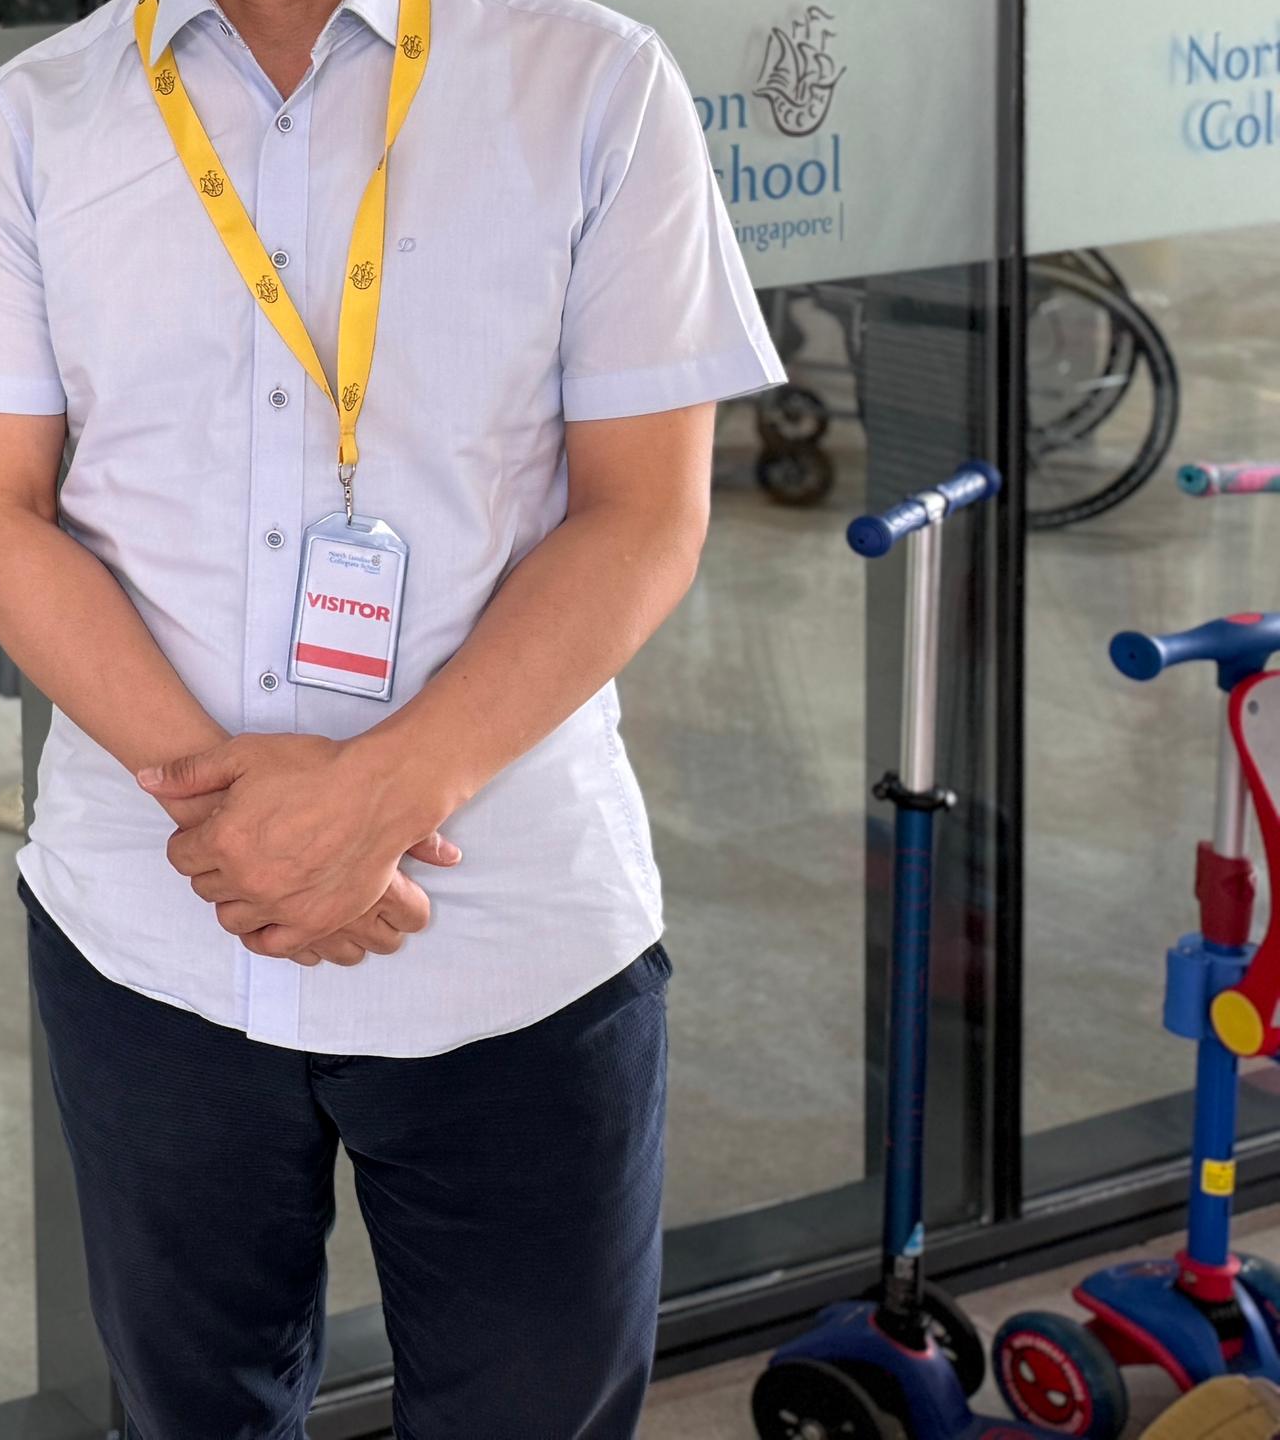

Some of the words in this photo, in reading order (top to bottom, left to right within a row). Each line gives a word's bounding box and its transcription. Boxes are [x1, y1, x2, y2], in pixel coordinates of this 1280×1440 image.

[712, 133, 842, 203] hool
[732, 214, 834, 252] ingapore
[307, 592, 391, 622] VISITOR
